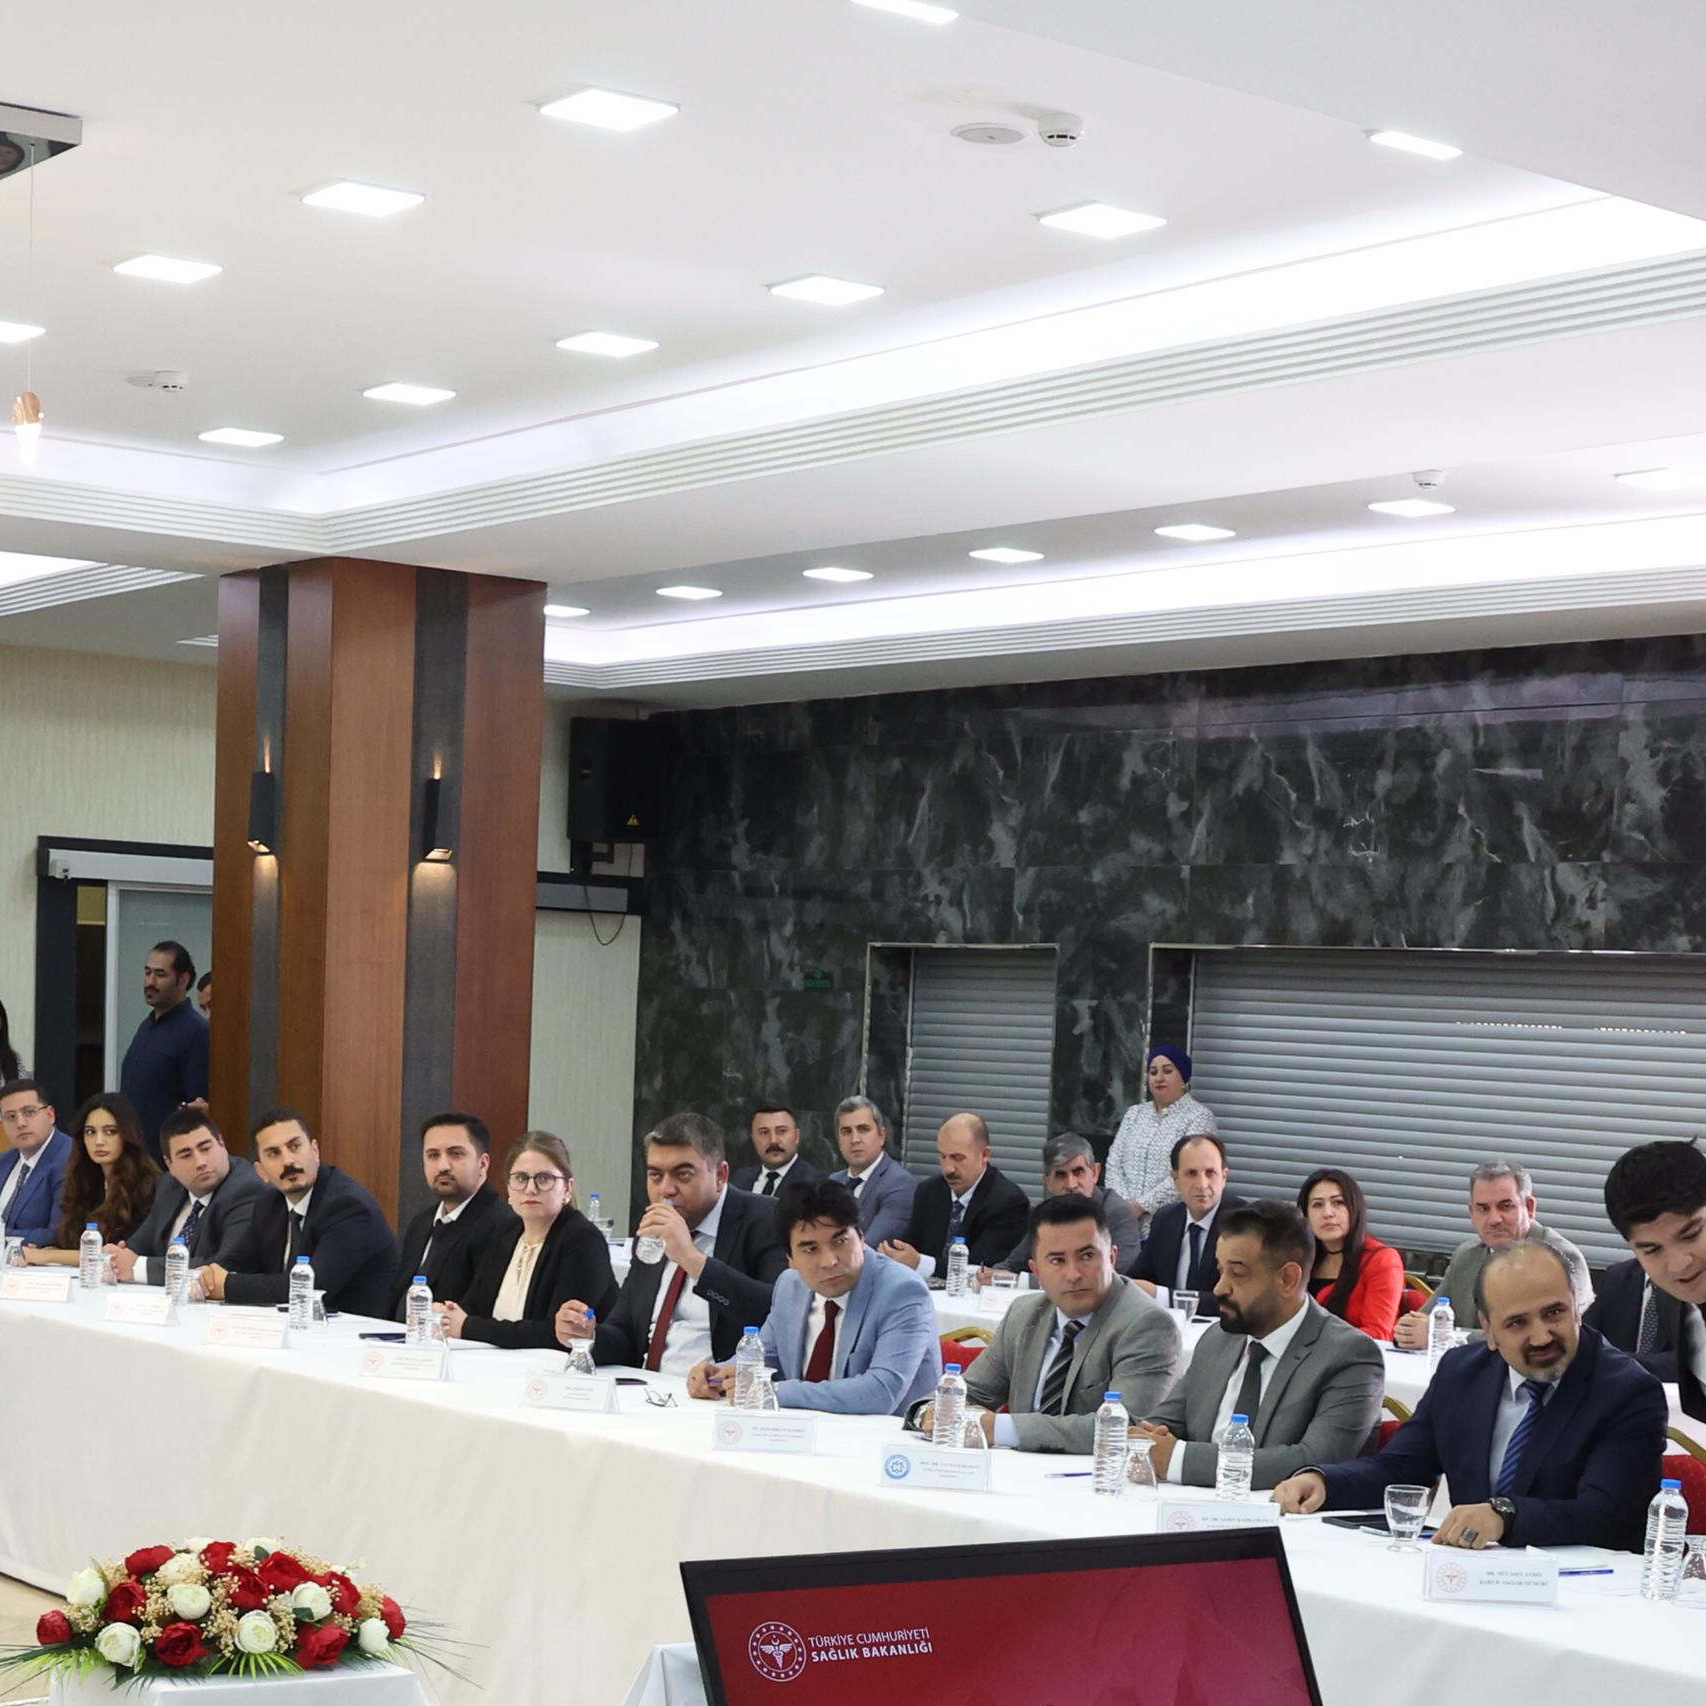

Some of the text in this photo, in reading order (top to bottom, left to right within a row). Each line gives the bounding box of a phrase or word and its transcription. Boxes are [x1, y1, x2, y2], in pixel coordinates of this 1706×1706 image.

[808, 1626, 930, 1649] TÜRKİYE CUMHURİYETİ
[811, 1640, 933, 1663] SAĞLIK BAKANLIĞI
